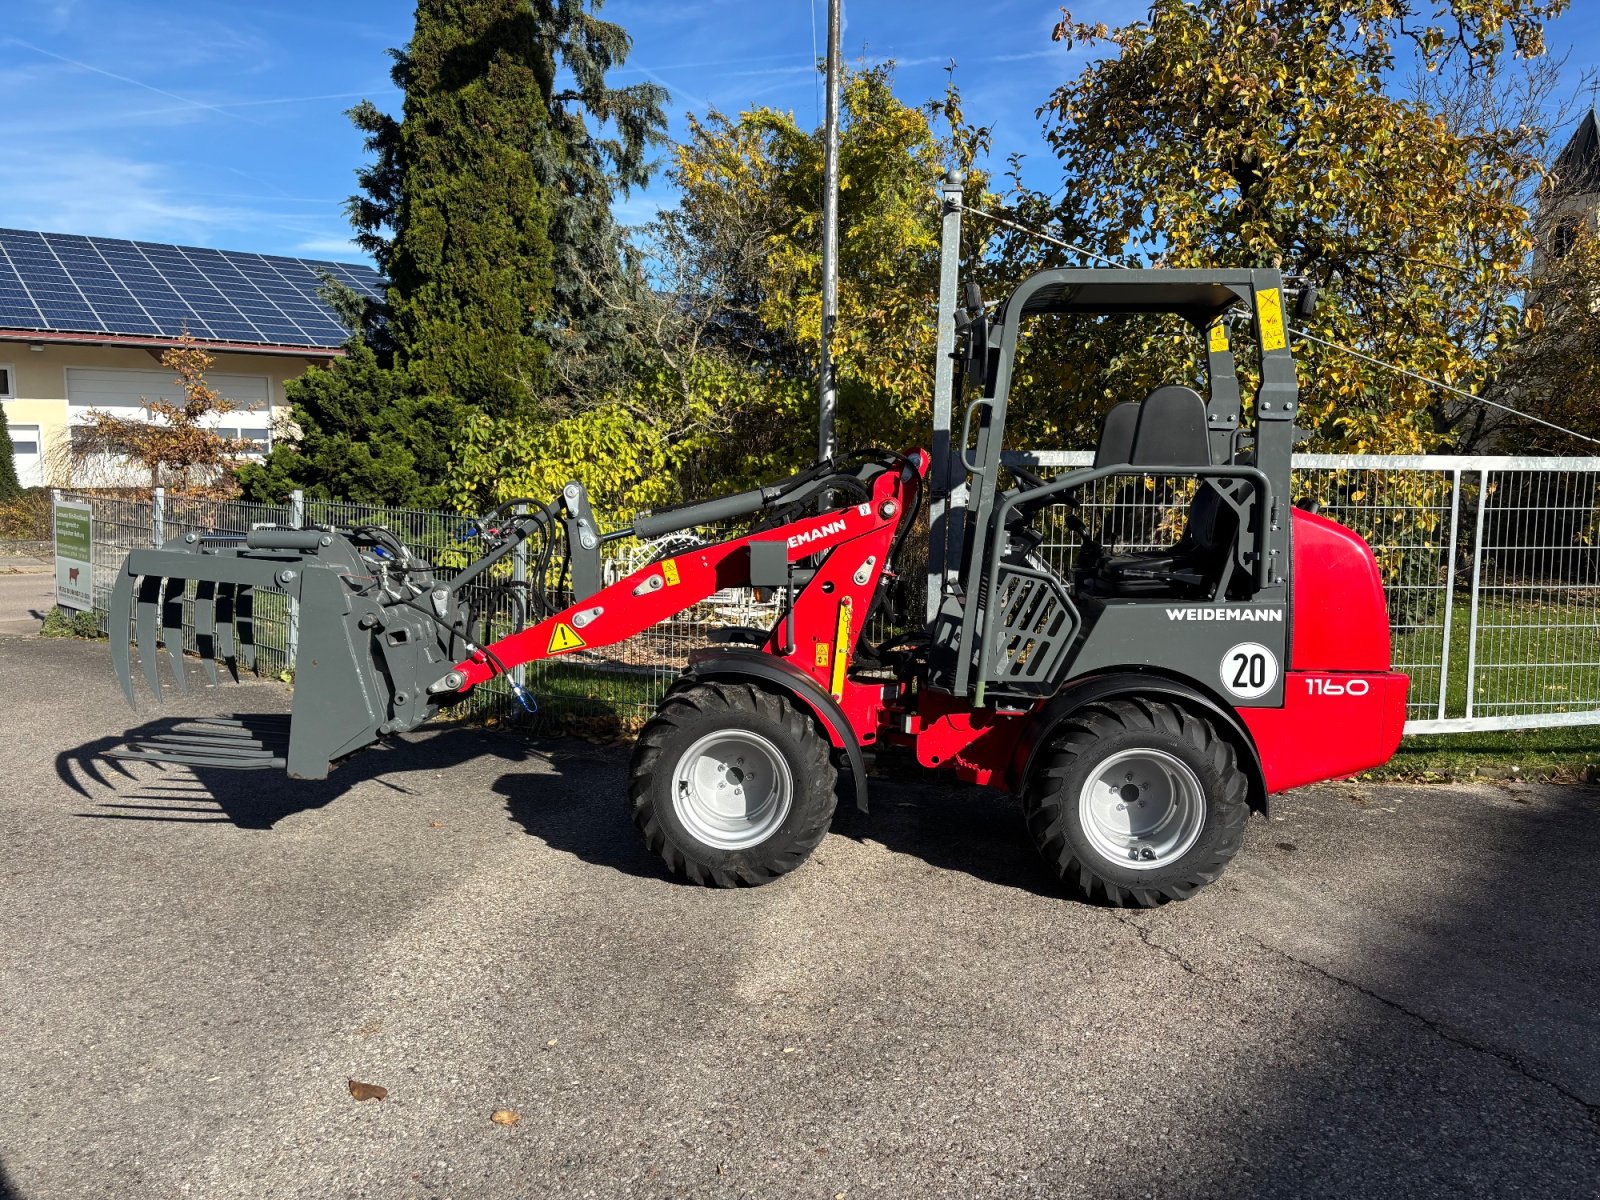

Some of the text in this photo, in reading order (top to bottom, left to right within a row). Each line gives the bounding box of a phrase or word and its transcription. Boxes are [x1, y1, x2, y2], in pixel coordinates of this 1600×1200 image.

[787, 519, 847, 549] EMANN
[1165, 608, 1283, 622] WEIDEMANN
[1232, 653, 1266, 688] 20
[1305, 678, 1370, 696] 1160
